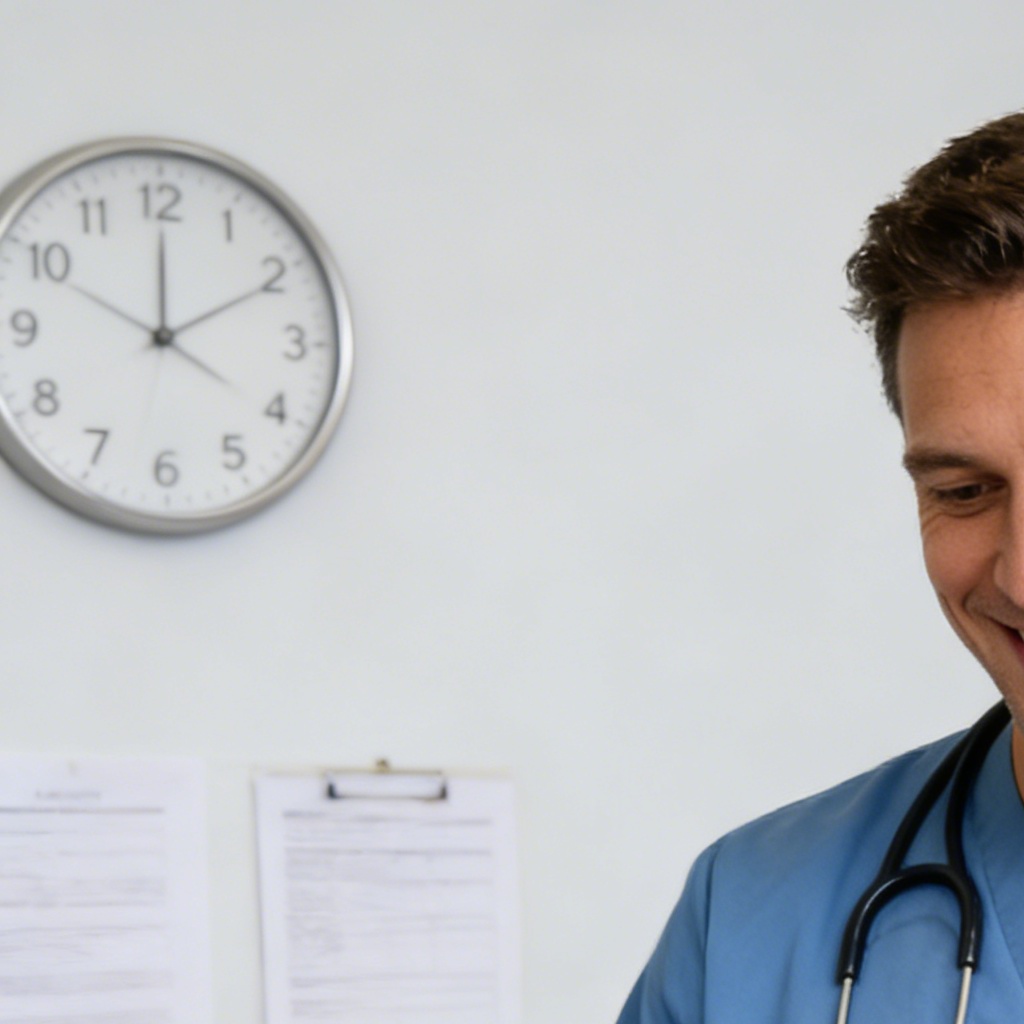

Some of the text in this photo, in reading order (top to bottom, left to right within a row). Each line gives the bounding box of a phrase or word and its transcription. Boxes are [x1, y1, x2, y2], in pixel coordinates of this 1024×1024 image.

[78, 198, 108, 236] 11
[137, 182, 183, 223] 12
[221, 208, 234, 243] 1
[28, 241, 72, 284] 10
[260, 255, 287, 294] 2
[9, 308, 39, 348] 9
[283, 323, 308, 362] 3
[32, 378, 61, 417] 8
[263, 390, 288, 426] 4
[83, 427, 111, 466] 7
[220, 433, 247, 471] 5
[152, 450, 180, 488] 6
